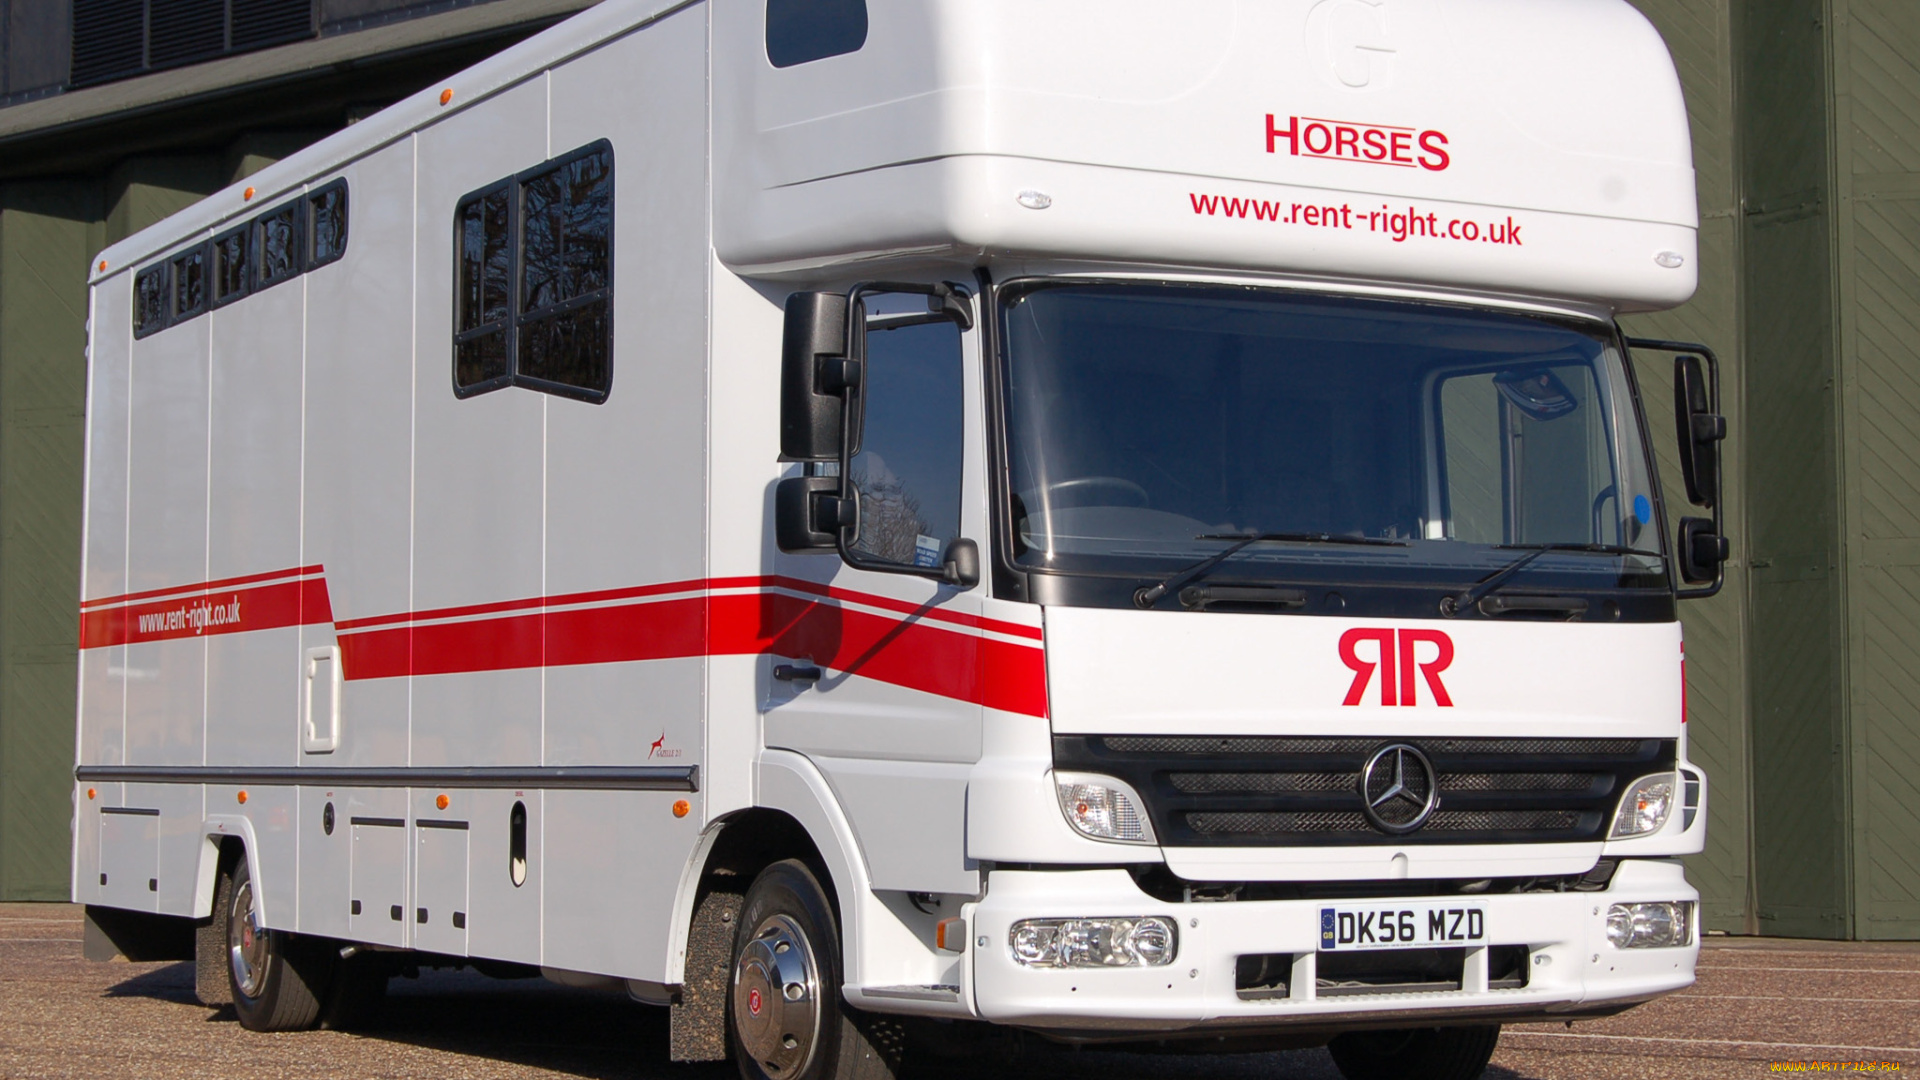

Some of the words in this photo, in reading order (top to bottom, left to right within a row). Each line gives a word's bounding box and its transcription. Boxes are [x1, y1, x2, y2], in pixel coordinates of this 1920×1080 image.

[1265, 113, 1450, 171] HORSES
[1189, 192, 1522, 246] www.rent-right.co.uk
[139, 594, 241, 634] www.rent-right.co.uk
[1338, 910, 1415, 944] DK56
[1428, 908, 1484, 941] MZD
